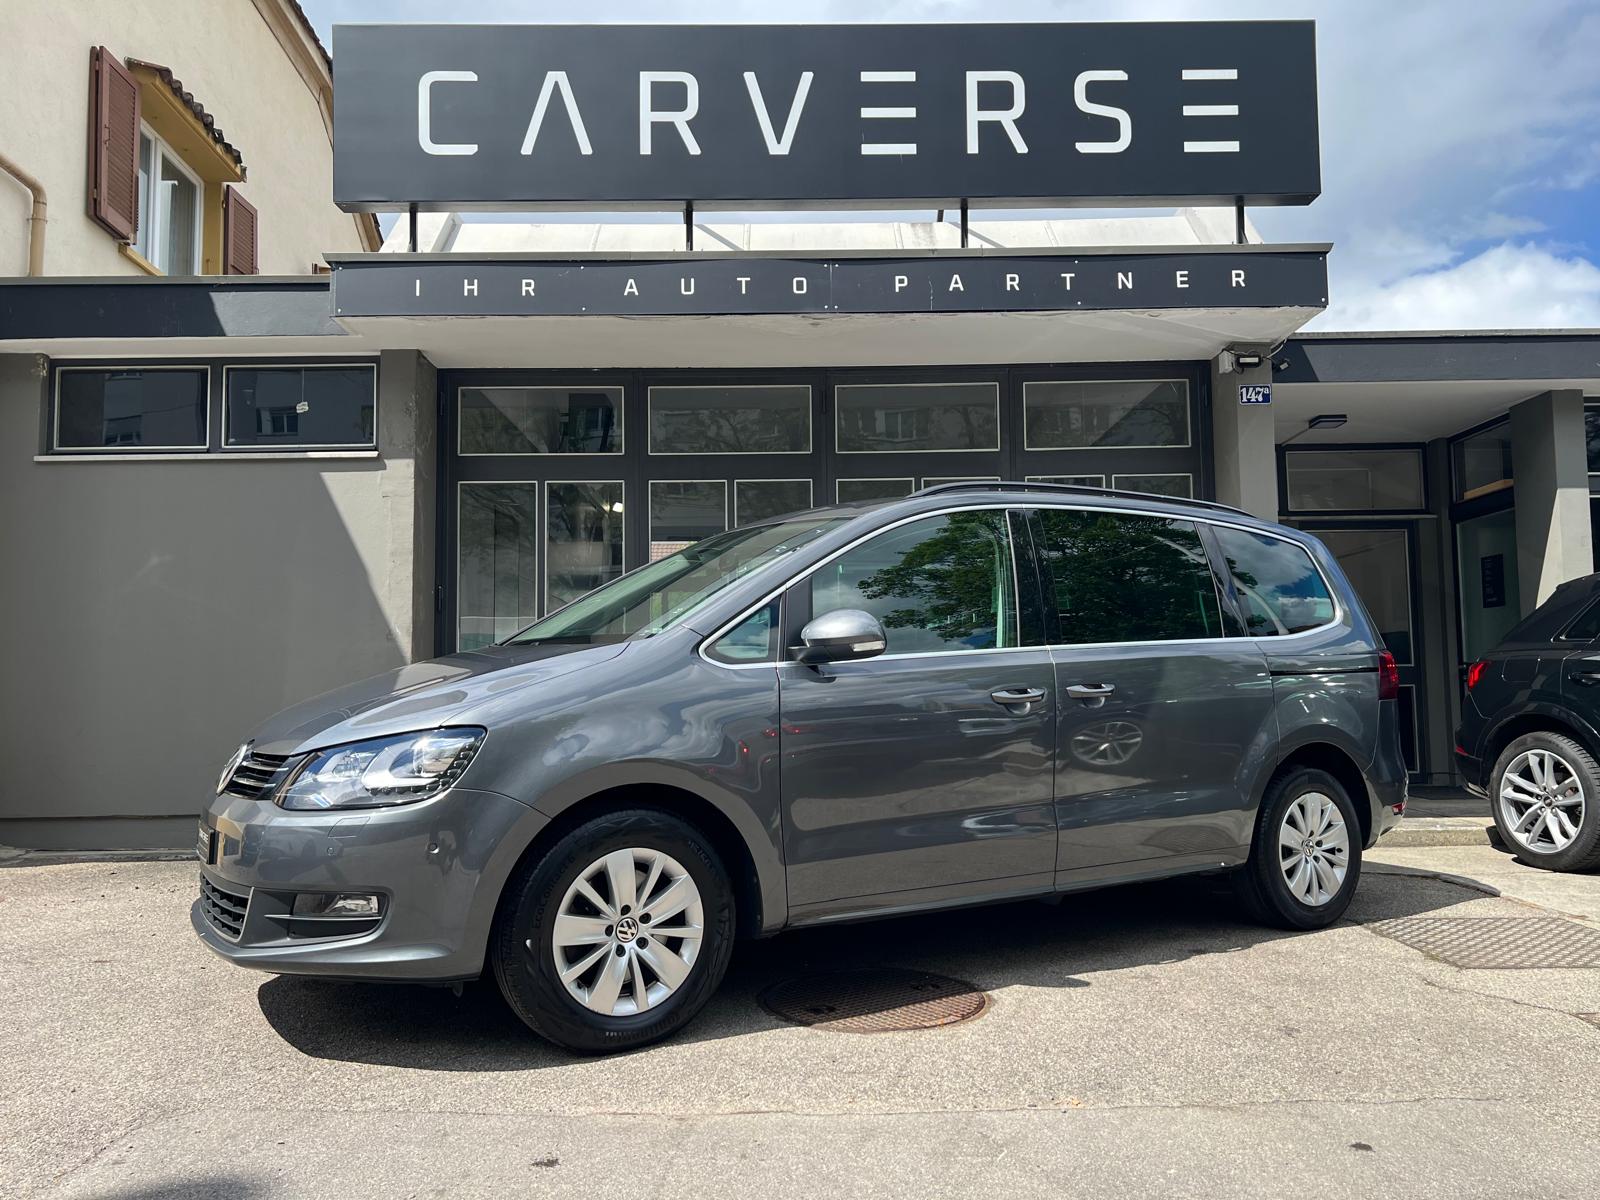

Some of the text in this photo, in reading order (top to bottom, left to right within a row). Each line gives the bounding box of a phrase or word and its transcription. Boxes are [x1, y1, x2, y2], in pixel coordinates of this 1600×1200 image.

[418, 69, 1239, 156] CARVERSE
[415, 269, 1247, 297] IHR AUTO PARTNER
